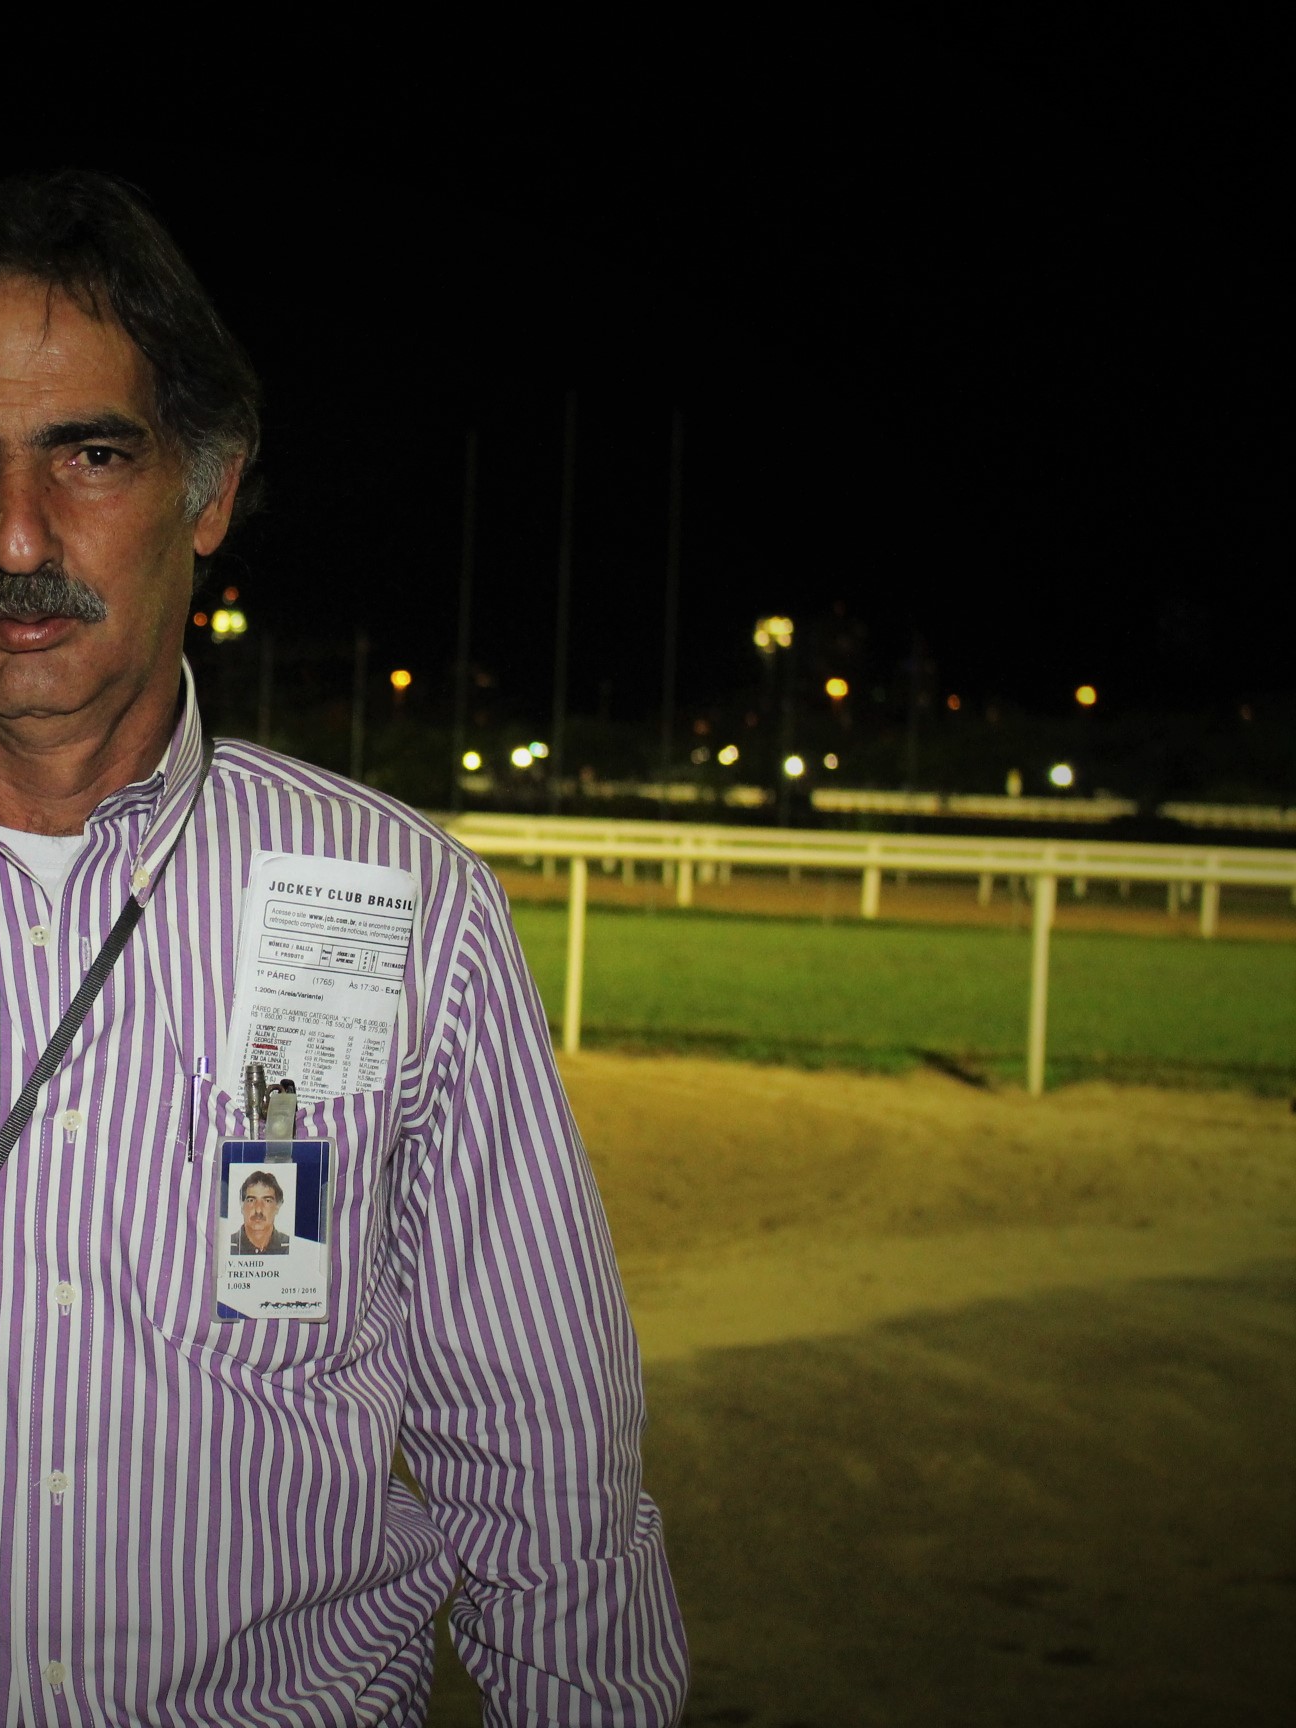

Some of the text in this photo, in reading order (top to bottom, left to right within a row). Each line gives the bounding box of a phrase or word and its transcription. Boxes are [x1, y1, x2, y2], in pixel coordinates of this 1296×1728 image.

[268, 880, 412, 911] JOCKEY CLUB BRASIL
[272, 908, 292, 916] Acesse
[270, 917, 299, 926] retrospecto
[267, 970, 296, 981] PÁREO
[313, 977, 335, 988] (1765)
[360, 984, 380, 992] 17:30
[254, 986, 324, 1001] 1.200m (Areia/Variante)
[253, 1004, 271, 1013] PÁREO
[282, 1009, 307, 1017] CLAIMING
[309, 1012, 338, 1021] CATEGORIA
